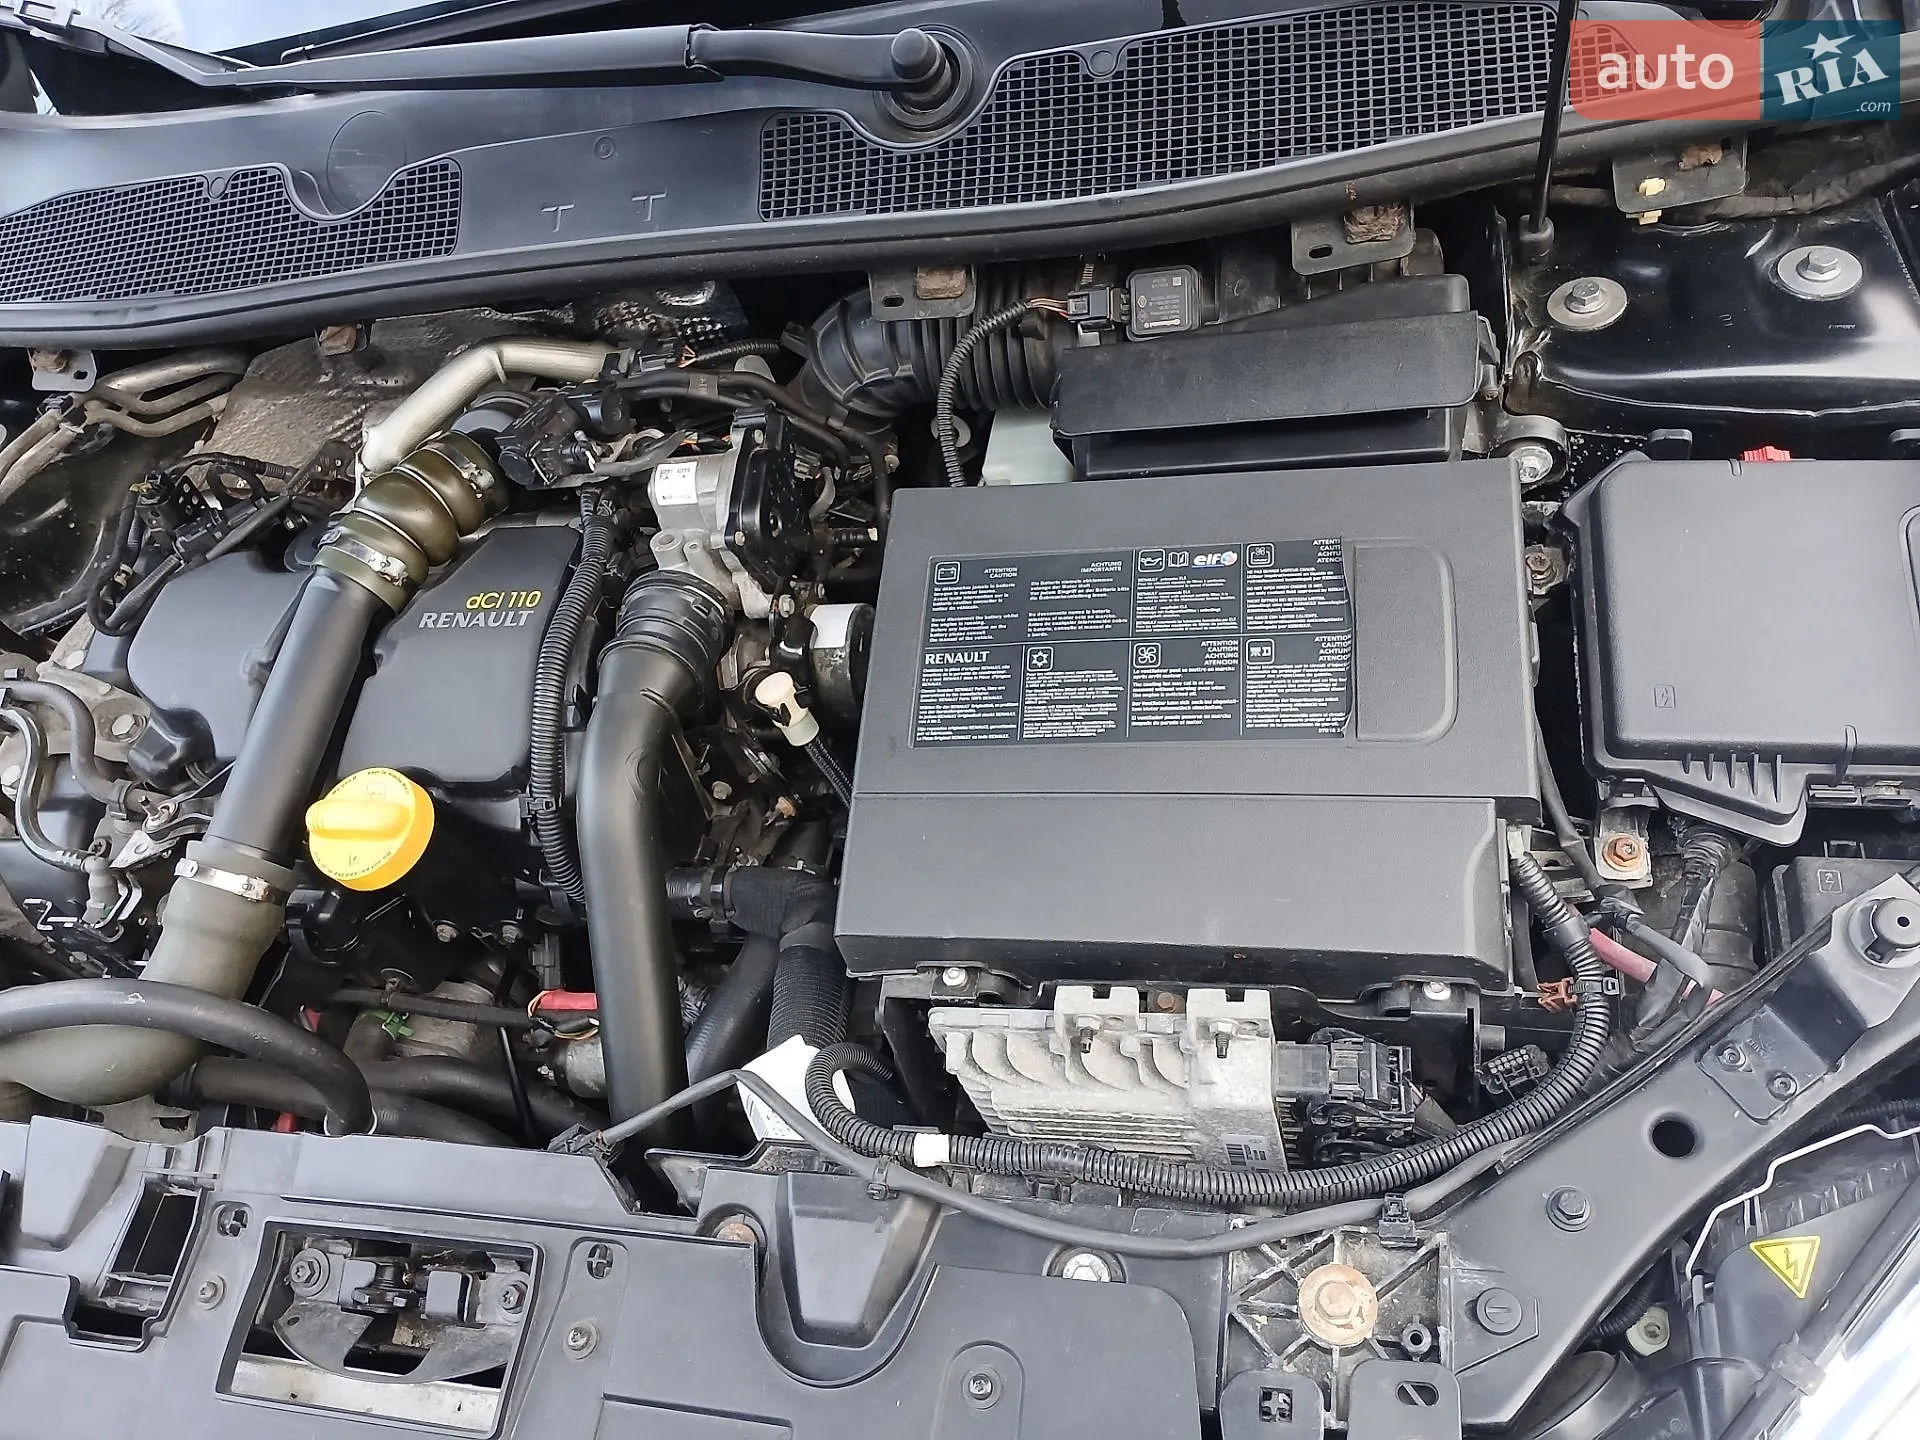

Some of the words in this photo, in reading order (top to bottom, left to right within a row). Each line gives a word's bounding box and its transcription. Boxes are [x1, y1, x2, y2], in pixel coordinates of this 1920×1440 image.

[509, 590, 542, 608] 110
[418, 610, 535, 628] RENAULT
[924, 650, 990, 664] RENAULT
